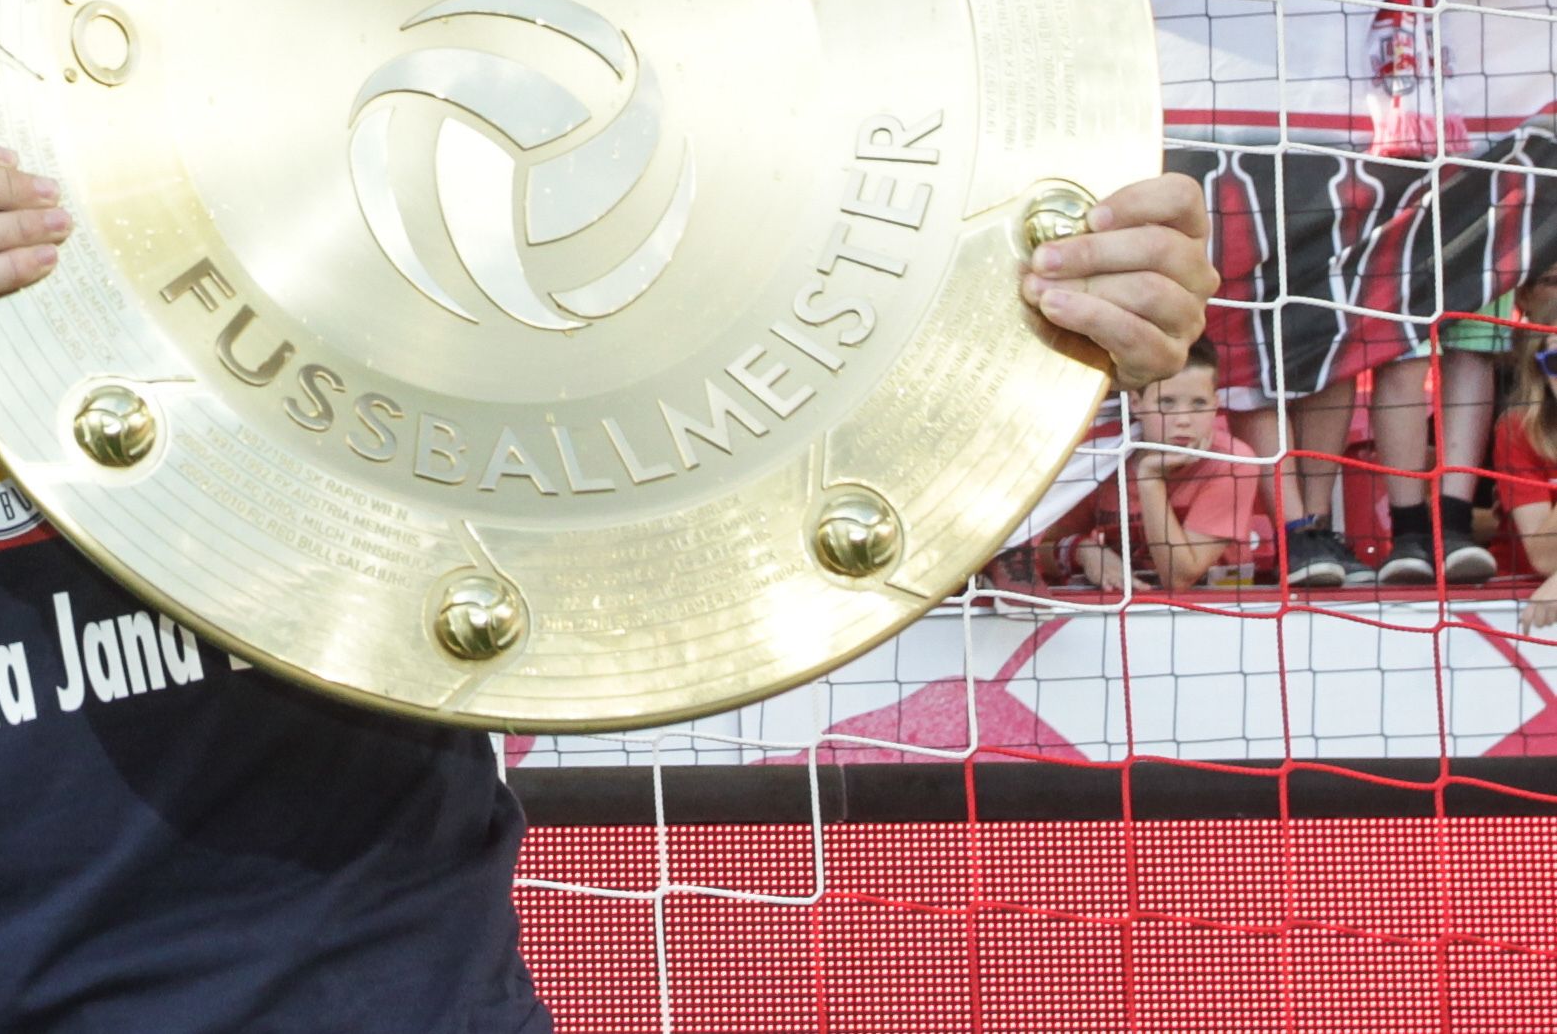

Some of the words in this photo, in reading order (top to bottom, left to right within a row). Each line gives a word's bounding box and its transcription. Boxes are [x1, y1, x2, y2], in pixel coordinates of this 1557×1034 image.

[72, 275, 122, 339] MEMPHIS
[96, 274, 127, 312] WIEN
[159, 109, 944, 495] FUSSBALLMEISTER
[258, 493, 299, 525] TIROL
[299, 515, 345, 546] MILCH
[290, 486, 351, 525] AUSTRIA
[352, 515, 421, 547] MEMPHIS
[323, 479, 367, 508] RAPID
[243, 507, 265, 528] FC
[264, 520, 295, 545] RED
[295, 536, 333, 563] BULL
[52, 591, 204, 712] Jana
